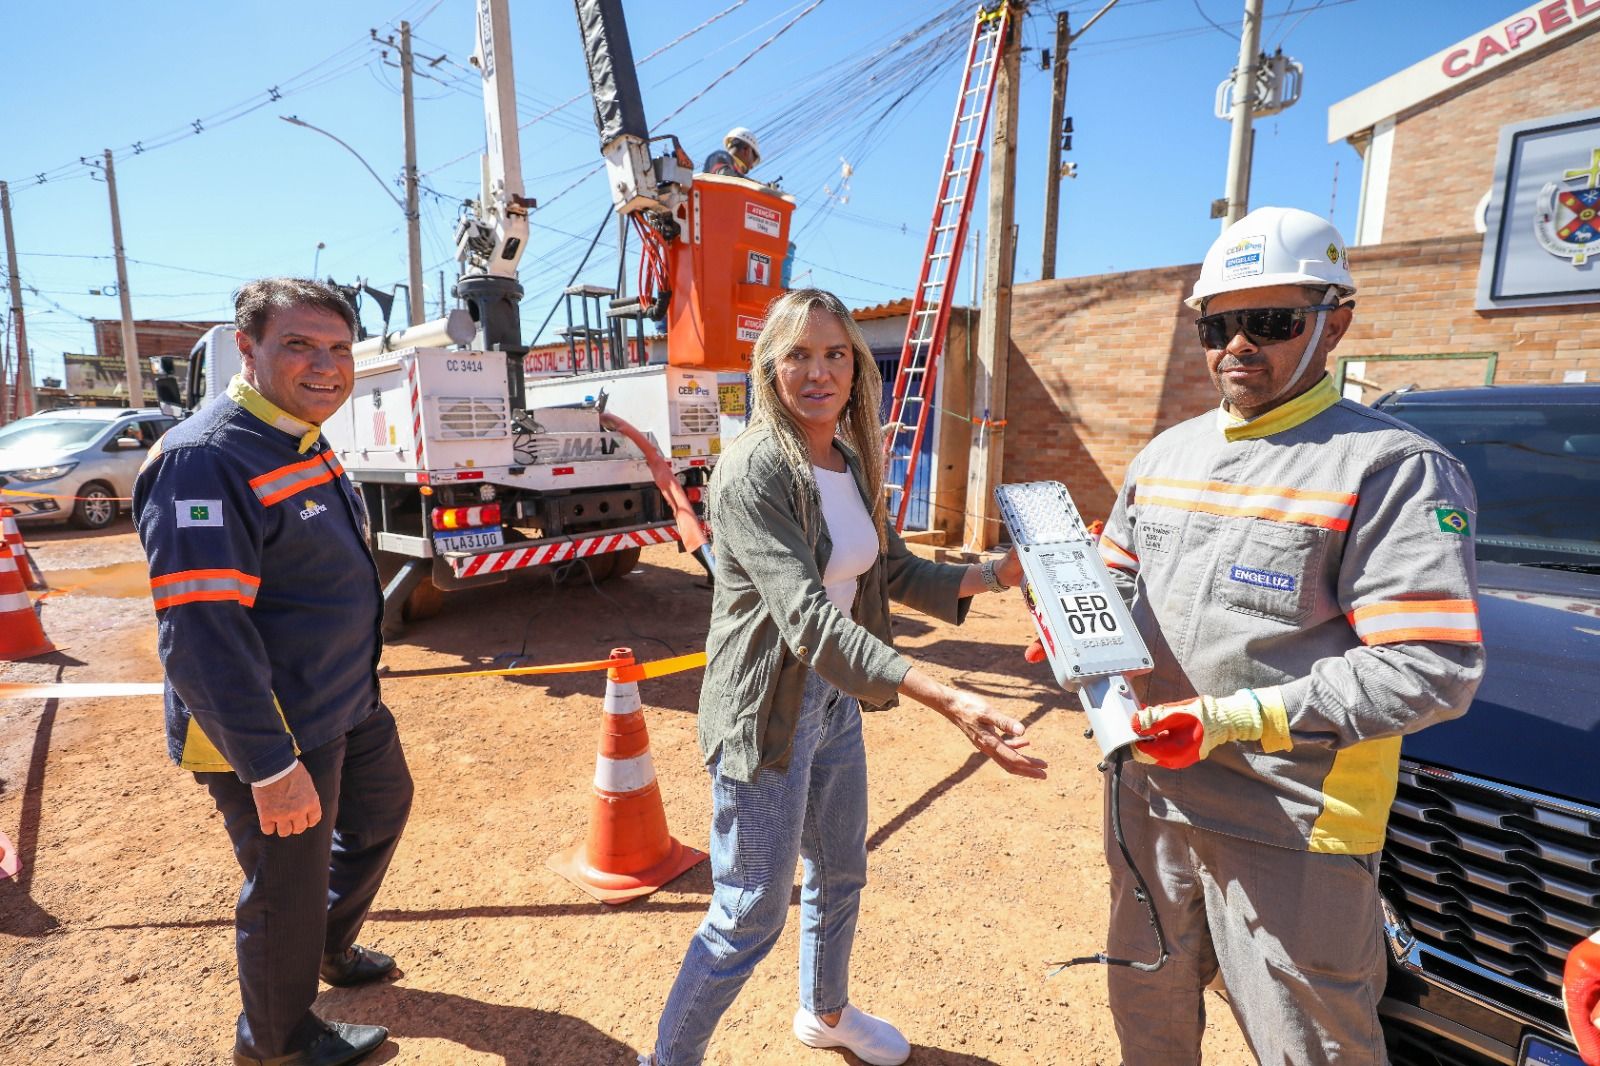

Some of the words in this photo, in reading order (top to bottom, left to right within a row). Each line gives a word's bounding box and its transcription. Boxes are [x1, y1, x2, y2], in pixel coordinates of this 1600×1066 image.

[447, 360, 459, 371] CC
[461, 360, 483, 372] 3414
[1234, 569, 1290, 588] ENGELUZ
[1060, 595, 1108, 613] LED
[1068, 612, 1117, 635] 070
